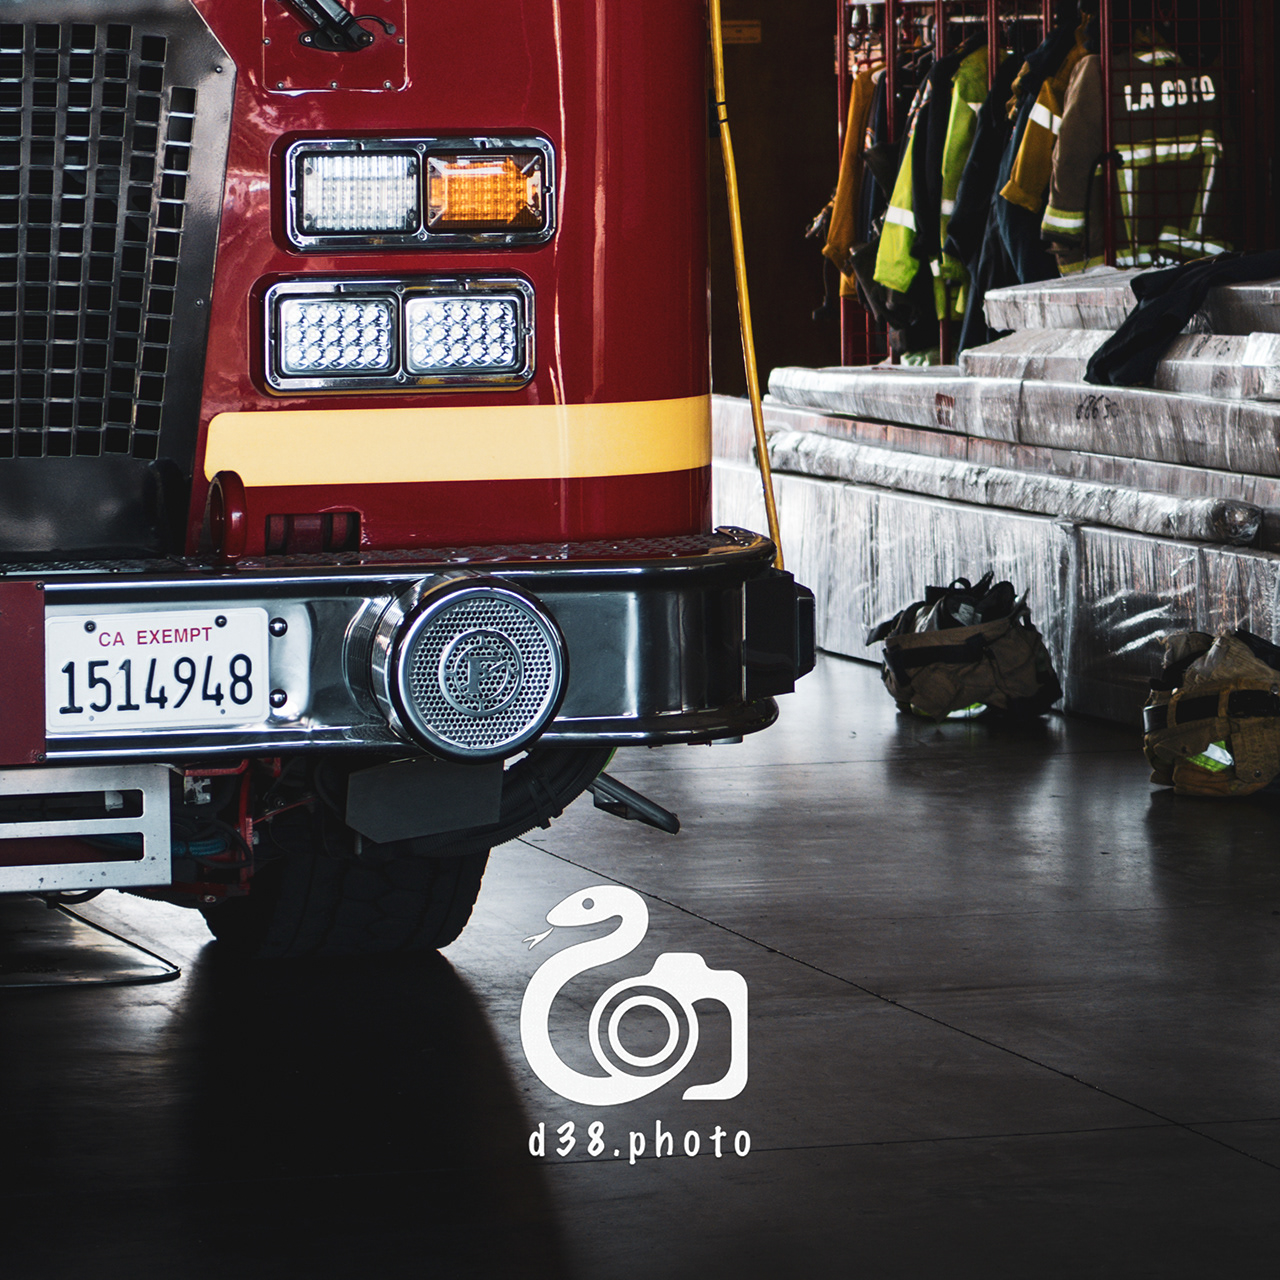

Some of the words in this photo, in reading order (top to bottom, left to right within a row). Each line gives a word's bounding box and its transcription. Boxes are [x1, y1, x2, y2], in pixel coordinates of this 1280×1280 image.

[98, 631, 125, 647] CA
[137, 627, 213, 645] EXEMPT
[59, 653, 253, 715] 1514948
